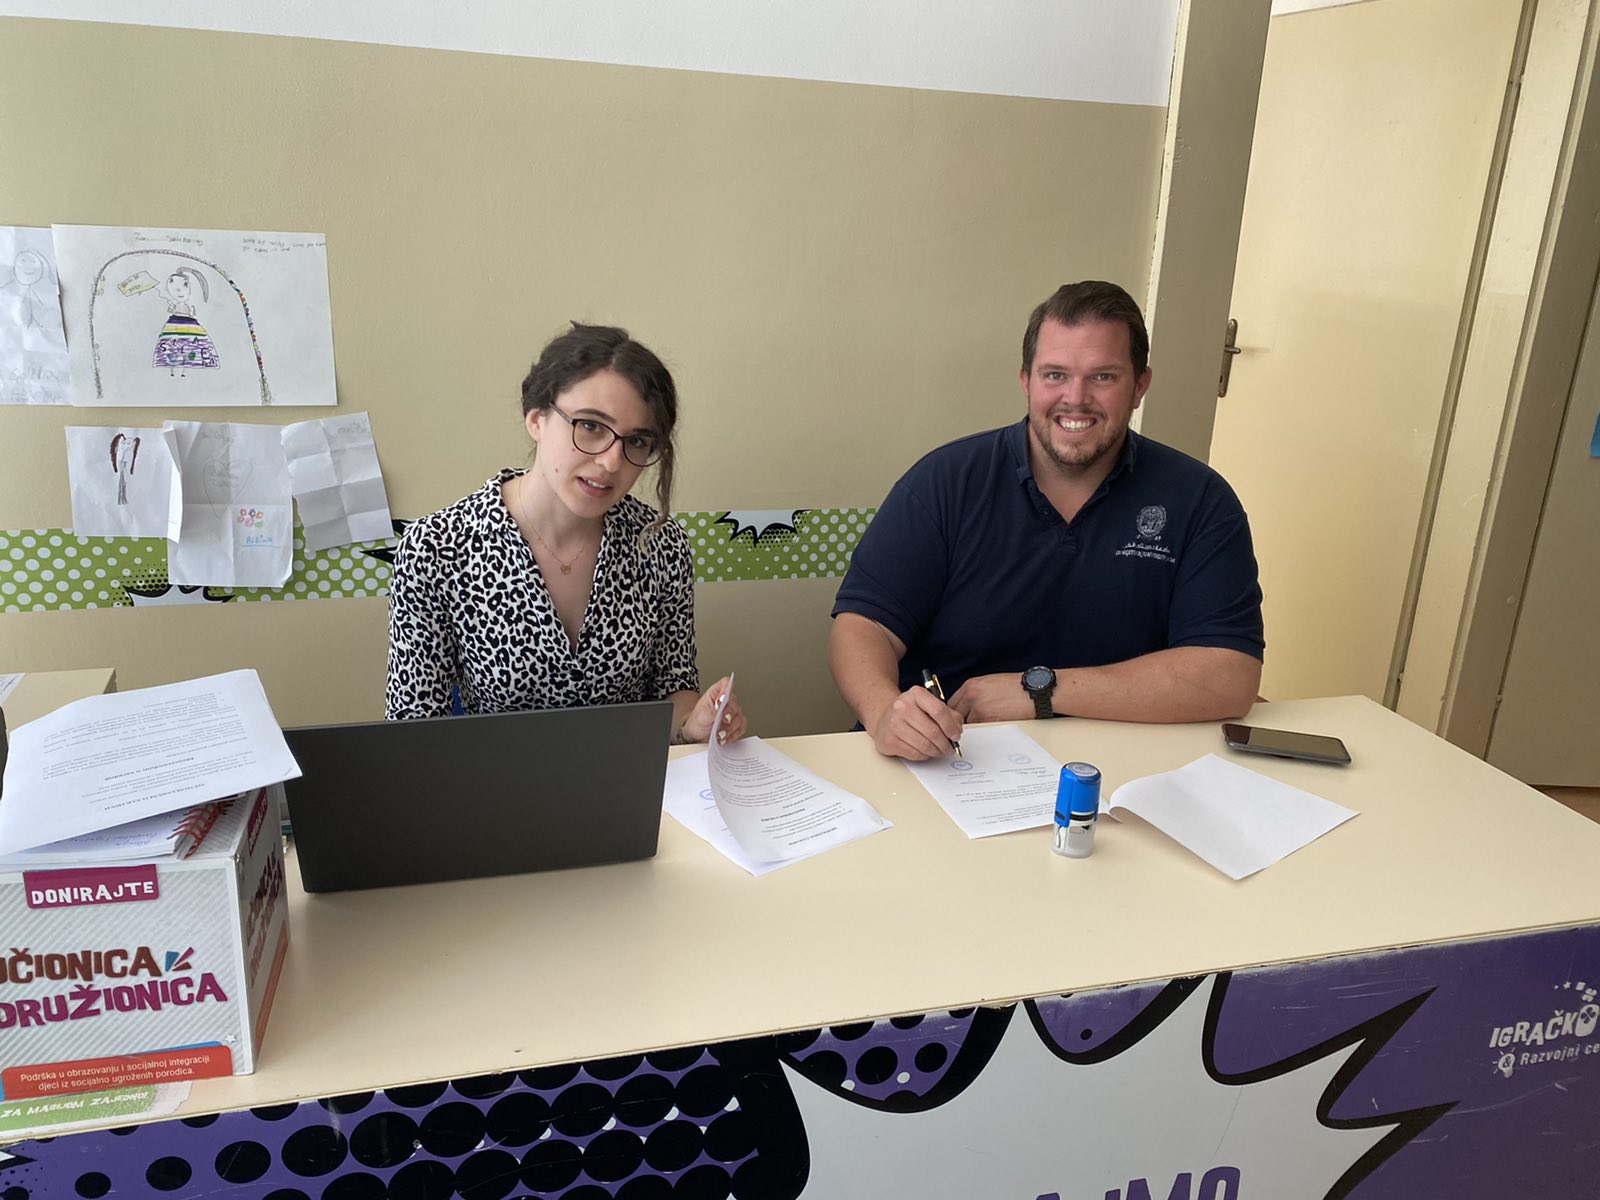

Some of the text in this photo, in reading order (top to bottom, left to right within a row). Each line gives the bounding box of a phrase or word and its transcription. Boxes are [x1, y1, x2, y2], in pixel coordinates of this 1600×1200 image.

[31, 881, 154, 905] DONIRAJTE
[0, 972, 228, 1029] DRUŽIONICA
[1520, 1044, 1580, 1065] Razvojni
[20, 1071, 57, 1082] Podrška
[67, 1065, 119, 1077] obrazovanju
[126, 1061, 168, 1072] socijalnoj
[169, 1055, 210, 1067] integraciji
[38, 1081, 60, 1091] djeci
[61, 1080, 69, 1088] iz
[71, 1077, 110, 1087] socijalno
[112, 1072, 154, 1084] ugroženih
